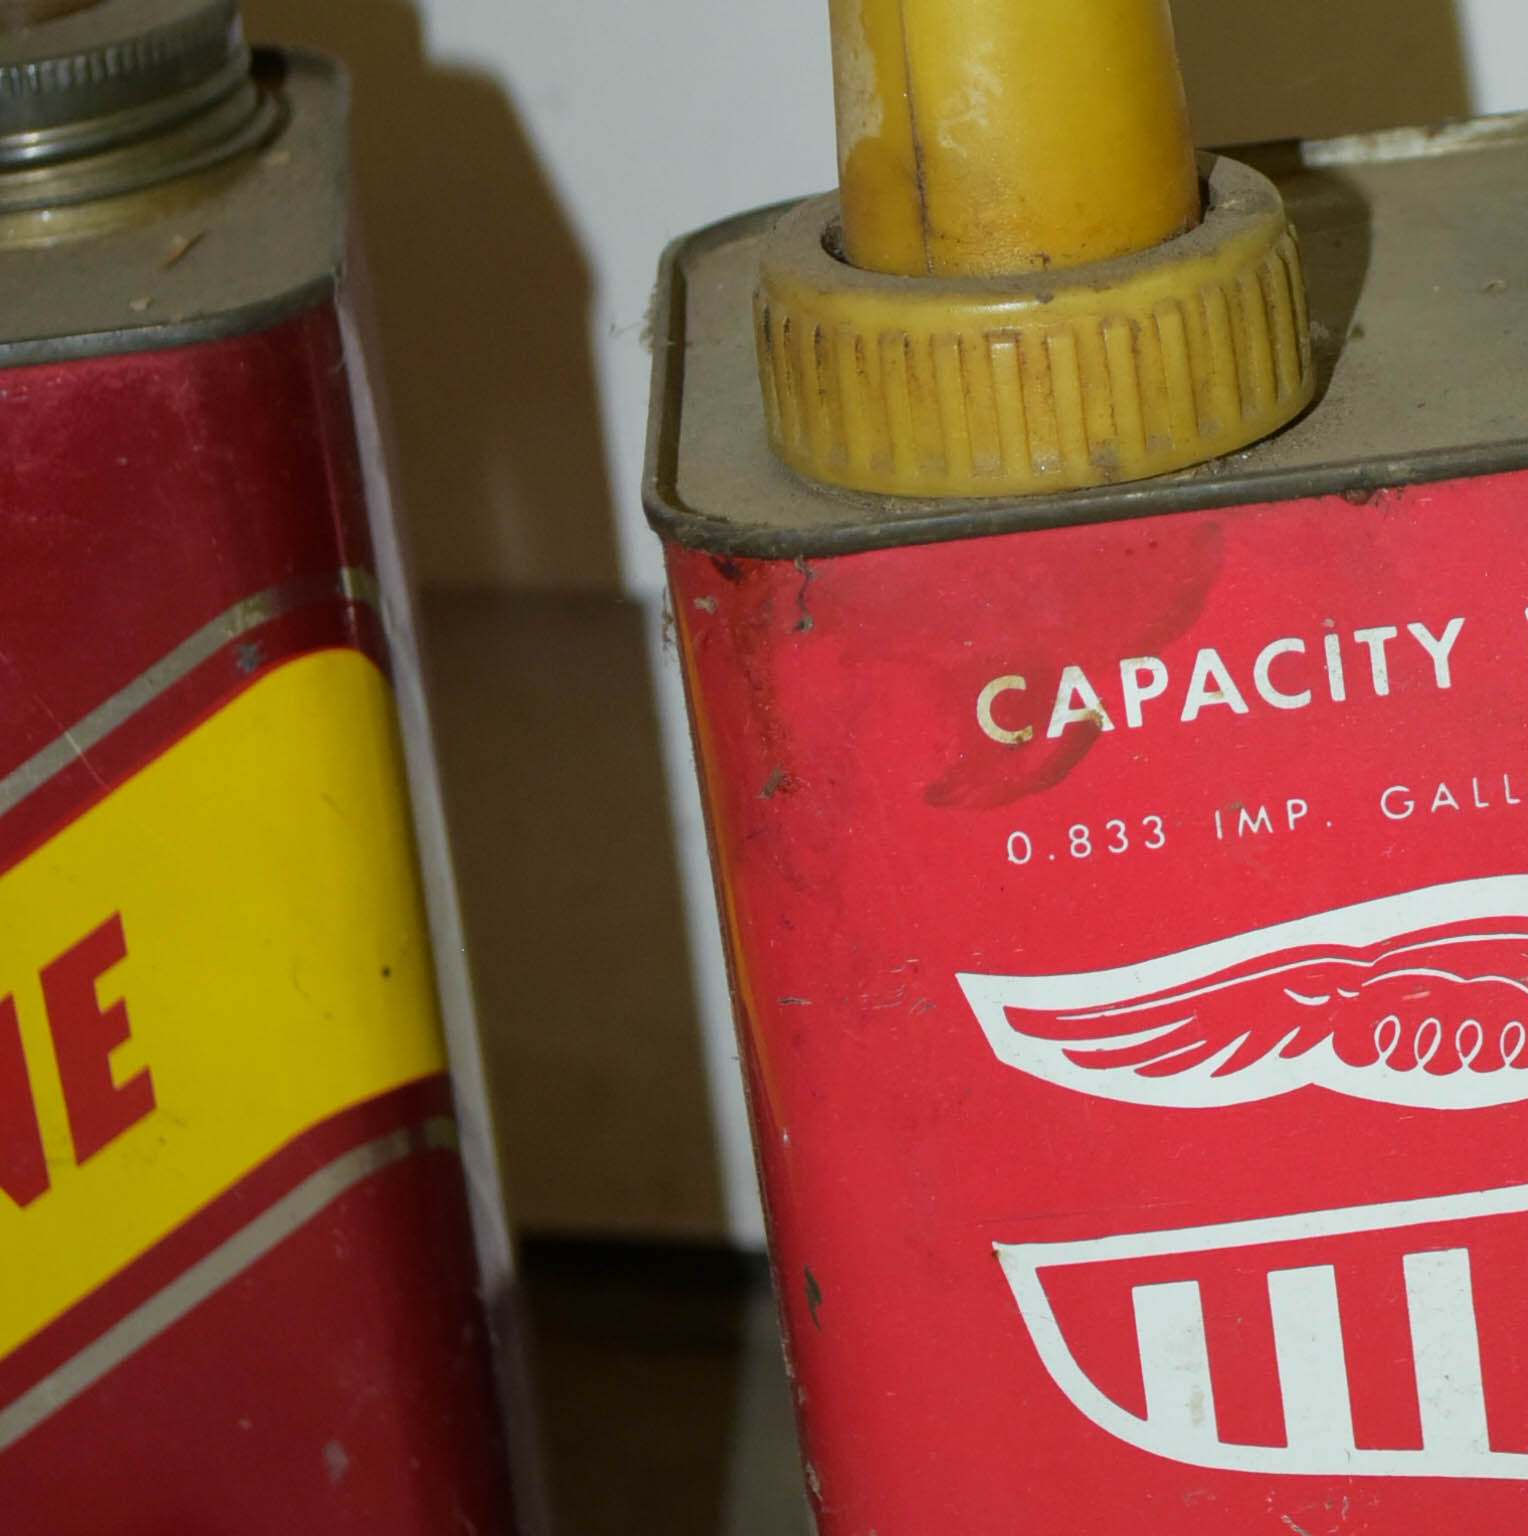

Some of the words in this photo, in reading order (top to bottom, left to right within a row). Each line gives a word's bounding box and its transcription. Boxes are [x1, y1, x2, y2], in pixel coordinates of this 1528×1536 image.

[976, 617, 1465, 745] CAPACITY
[1006, 814, 1168, 866] 0.833
[1214, 798, 1333, 841] IMP.
